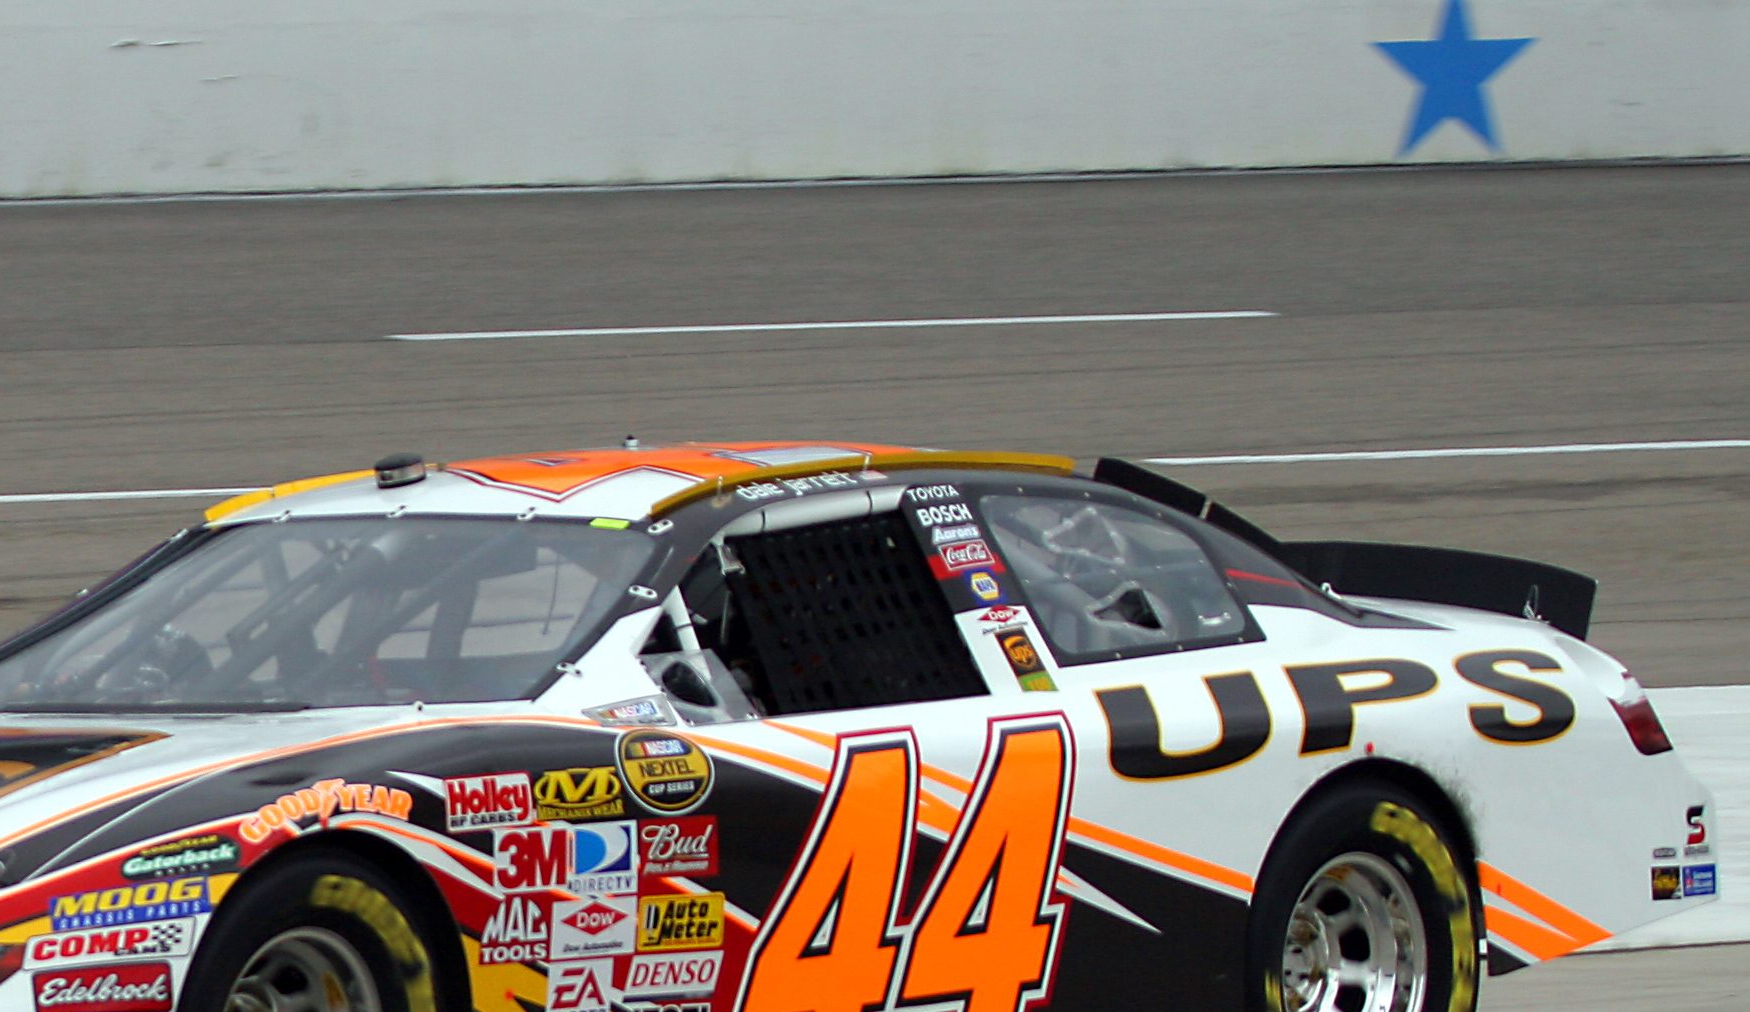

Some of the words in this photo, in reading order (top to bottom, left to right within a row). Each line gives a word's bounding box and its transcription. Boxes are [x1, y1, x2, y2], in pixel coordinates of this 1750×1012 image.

[736, 482, 784, 499] dale
[777, 470, 857, 496] jarrett
[906, 485, 960, 502] TOYOTA
[917, 503, 973, 527] BOSCH
[1094, 649, 1576, 782] UPS
[647, 740, 684, 754] NASCAR
[639, 758, 696, 777] NEXTEL
[448, 777, 529, 820] Holley
[648, 783, 665, 795] CUP
[667, 781, 695, 793] SERIES
[240, 778, 413, 843] GOODYEAR
[643, 823, 714, 860] Bud
[123, 843, 238, 876] Gatorback
[497, 829, 569, 890] 3M
[53, 876, 205, 918] MOOG
[572, 876, 634, 892] DIRECTV
[60, 909, 134, 929] CHASSIS
[146, 900, 201, 917] PARTS
[482, 895, 549, 944] MAC
[663, 899, 709, 919] Auto
[659, 918, 718, 940] Meter
[33, 928, 150, 961] COMP
[482, 943, 547, 963] TOOLS
[631, 958, 715, 987] DENSO
[39, 975, 169, 1006] Edelbrock
[551, 967, 606, 1010] EA
